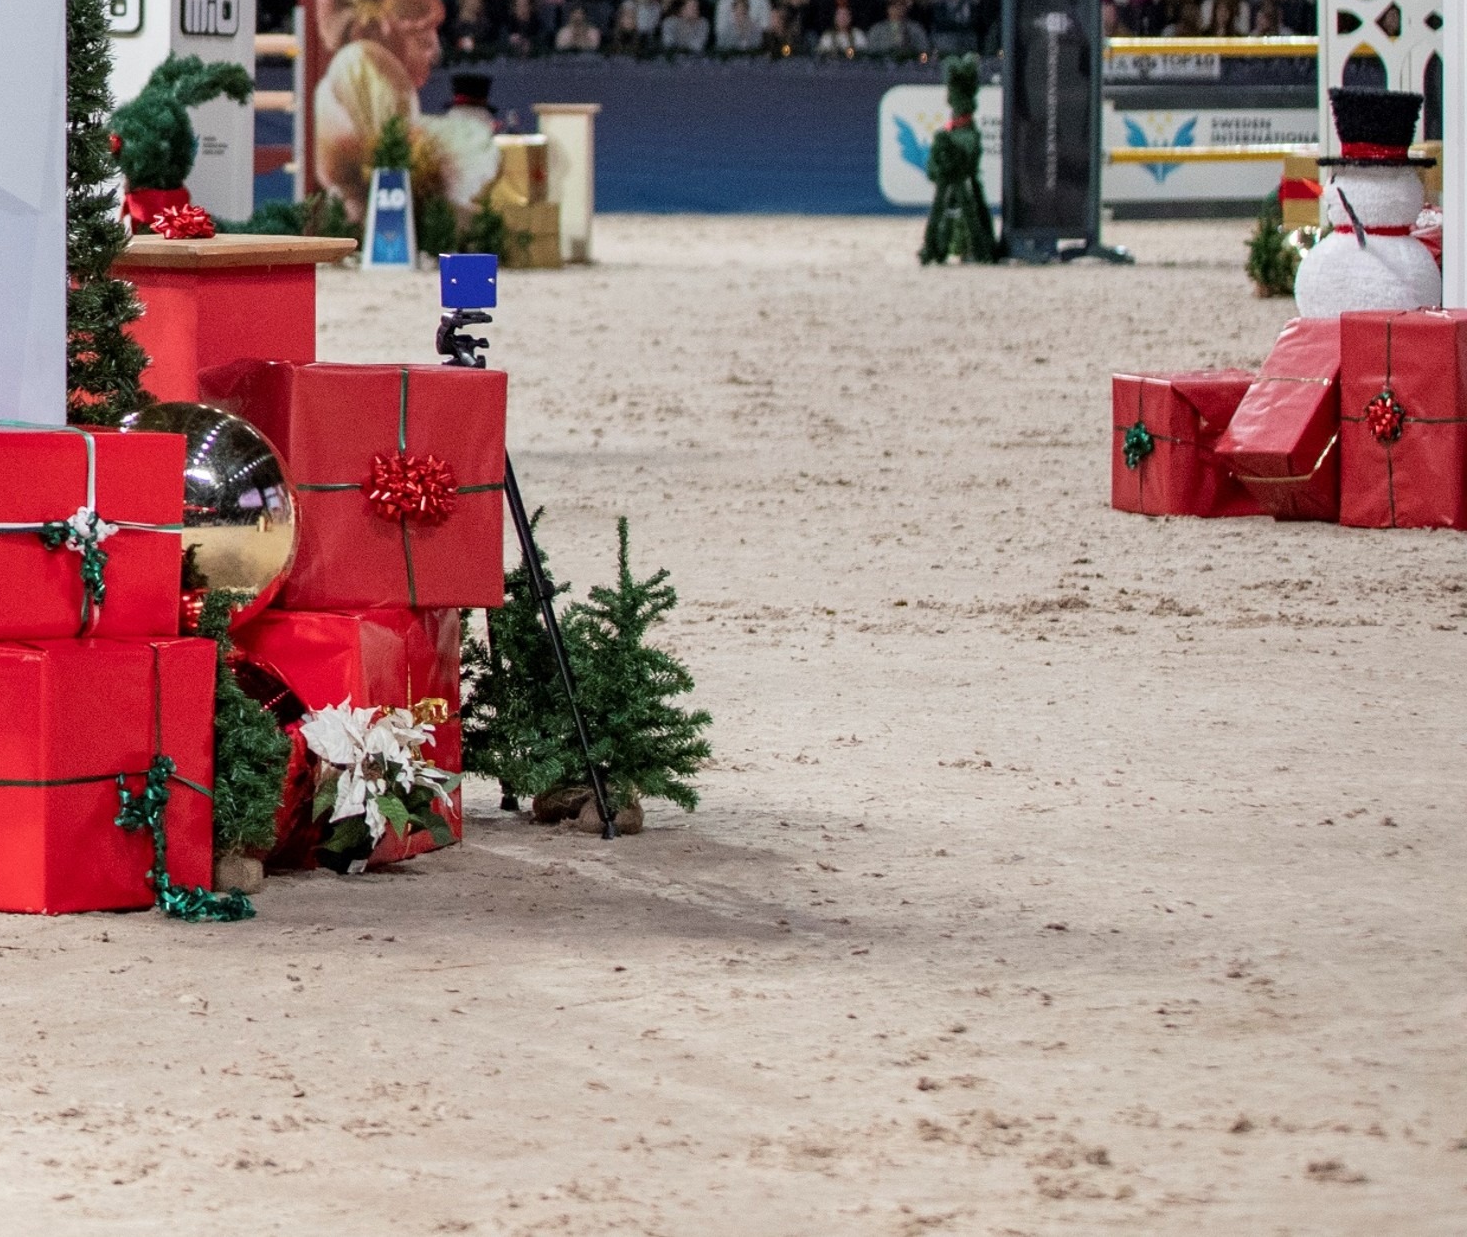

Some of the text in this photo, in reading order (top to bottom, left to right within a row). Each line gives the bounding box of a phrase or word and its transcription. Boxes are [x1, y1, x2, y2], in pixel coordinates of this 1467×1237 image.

[1211, 116, 1272, 129] SWEDEN
[1211, 131, 1319, 143] INTERNATIONA
[377, 188, 406, 210] 10
